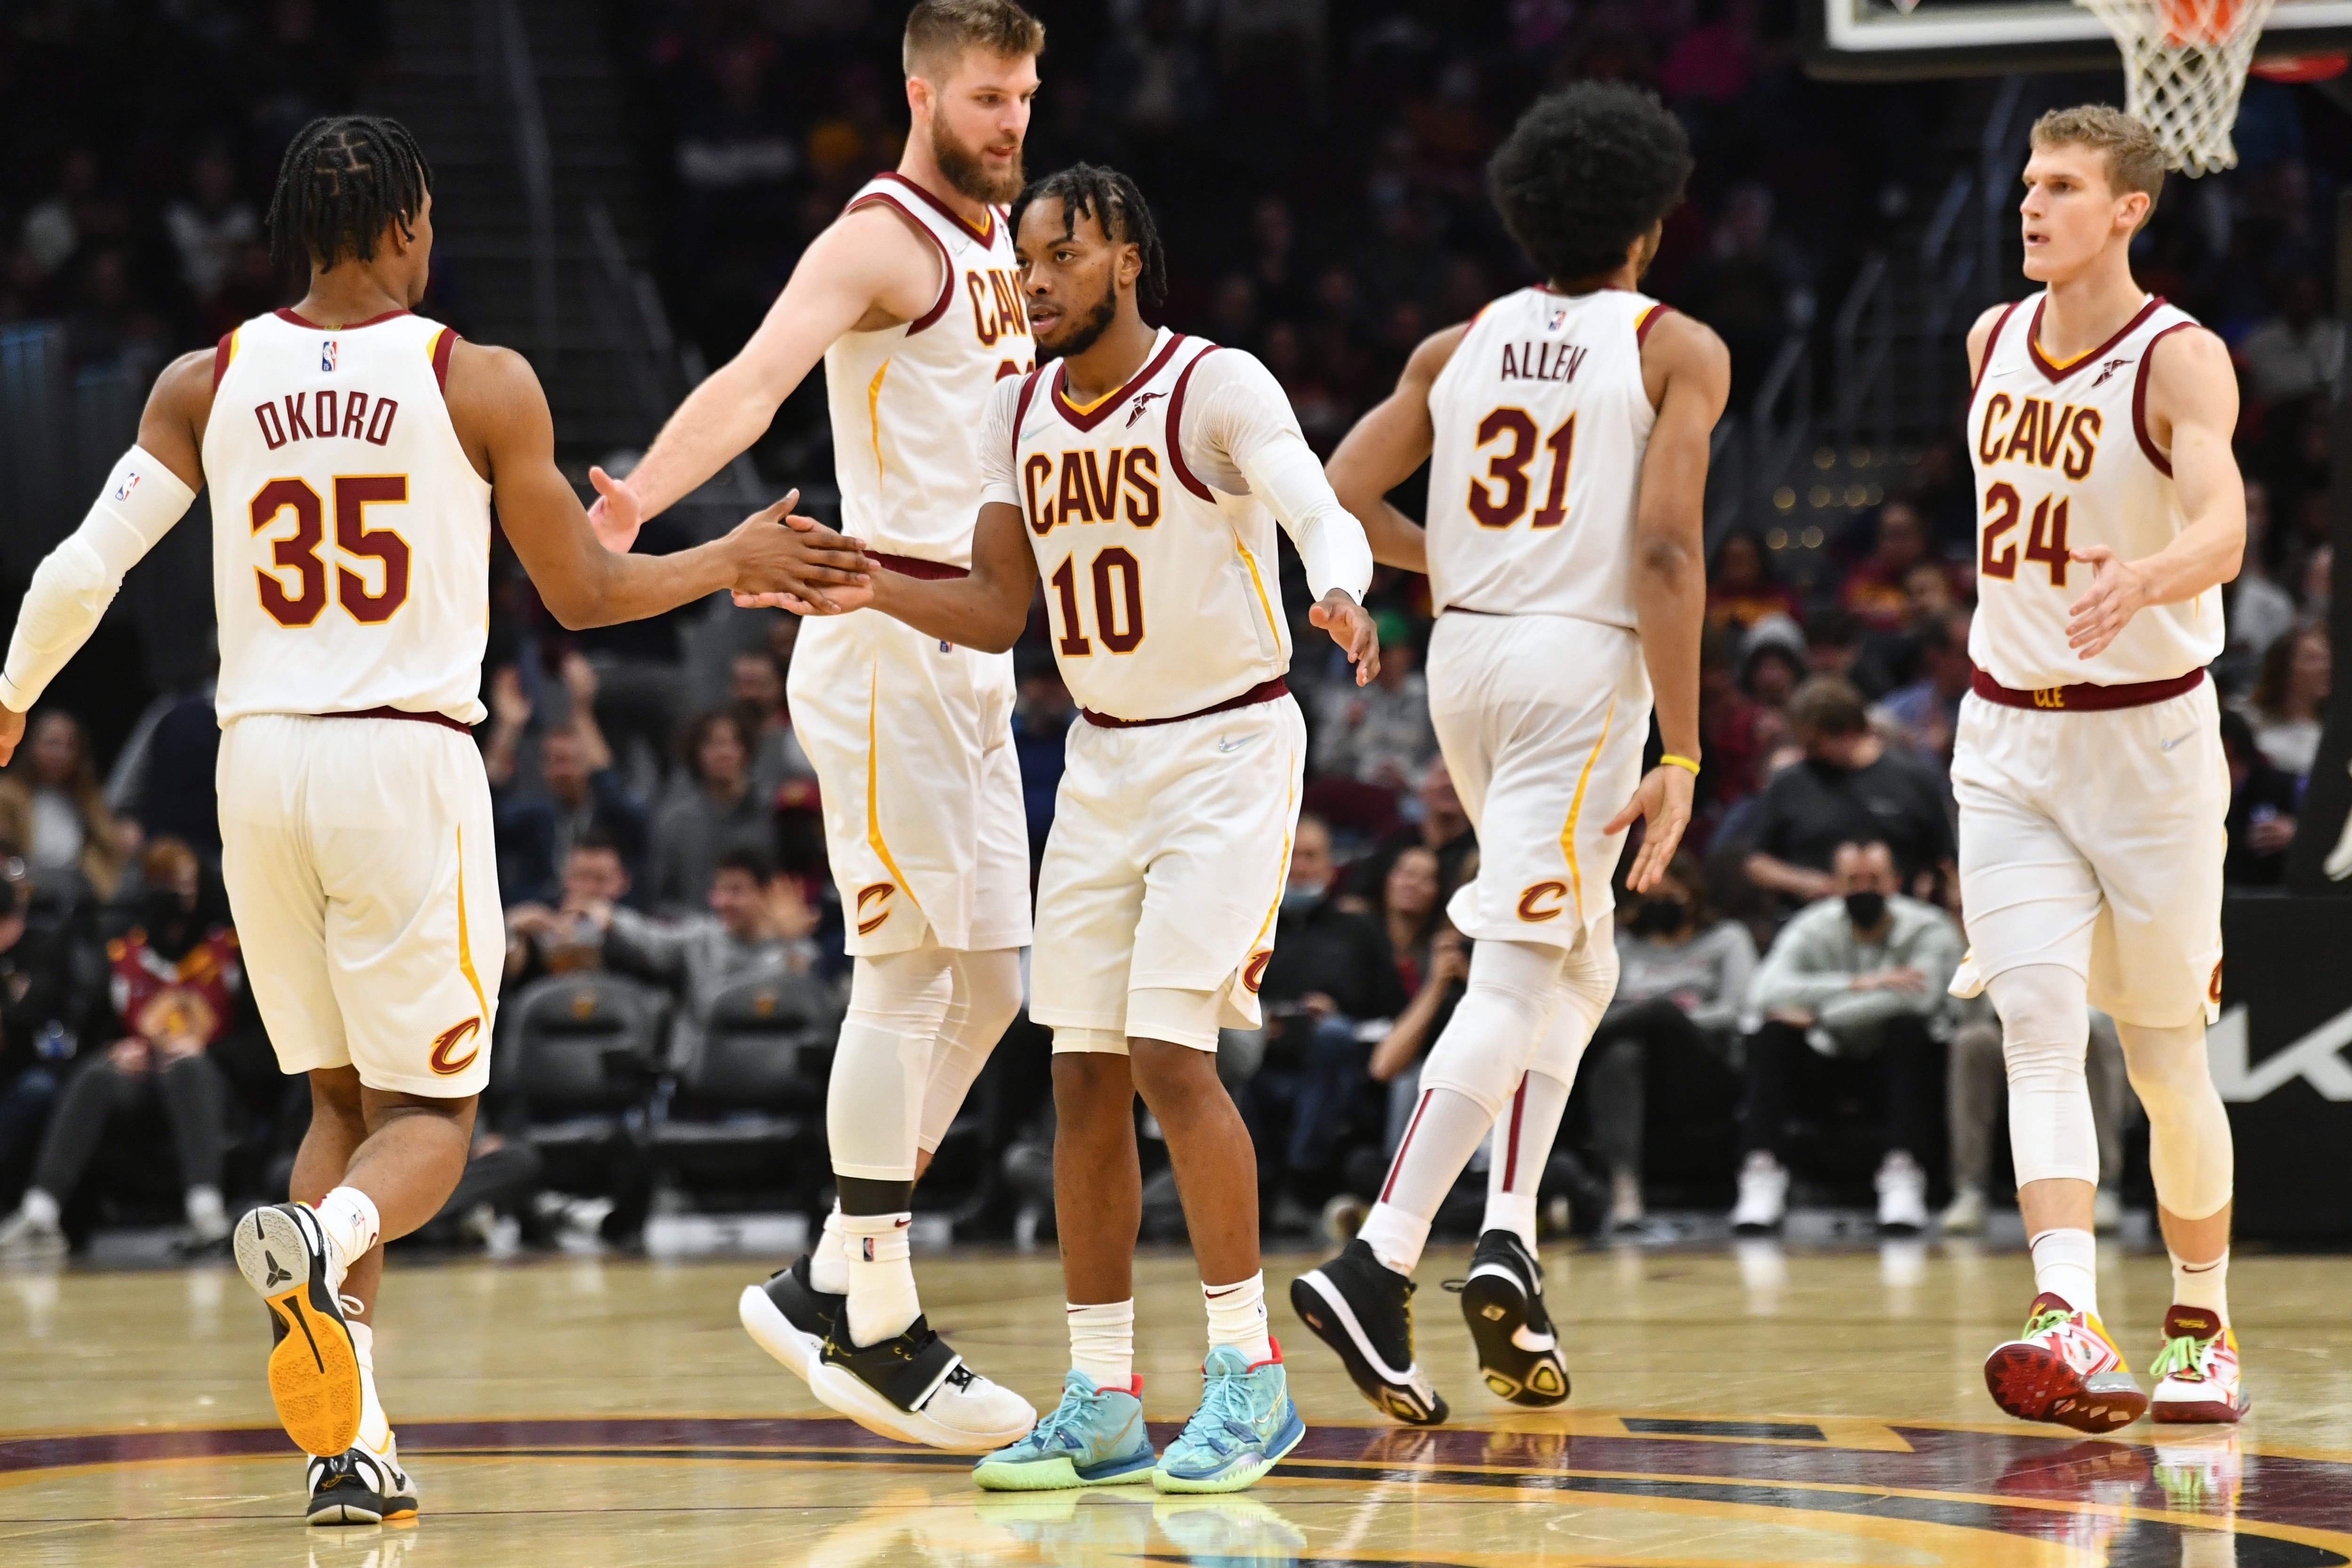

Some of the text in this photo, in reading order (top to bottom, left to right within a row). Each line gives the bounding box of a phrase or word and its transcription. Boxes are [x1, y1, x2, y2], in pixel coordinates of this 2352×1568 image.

[966, 268, 1030, 347] CAV
[1502, 342, 1588, 383] ALLEN
[255, 390, 398, 450] OKORO
[1979, 392, 2102, 481] CAVS
[1025, 445, 1160, 537] CAVS
[1467, 405, 1576, 532] 31
[248, 473, 412, 629] 35
[1982, 480, 2071, 588] 24
[1051, 545, 1146, 658] 10
[2033, 686, 2065, 708] CLE
